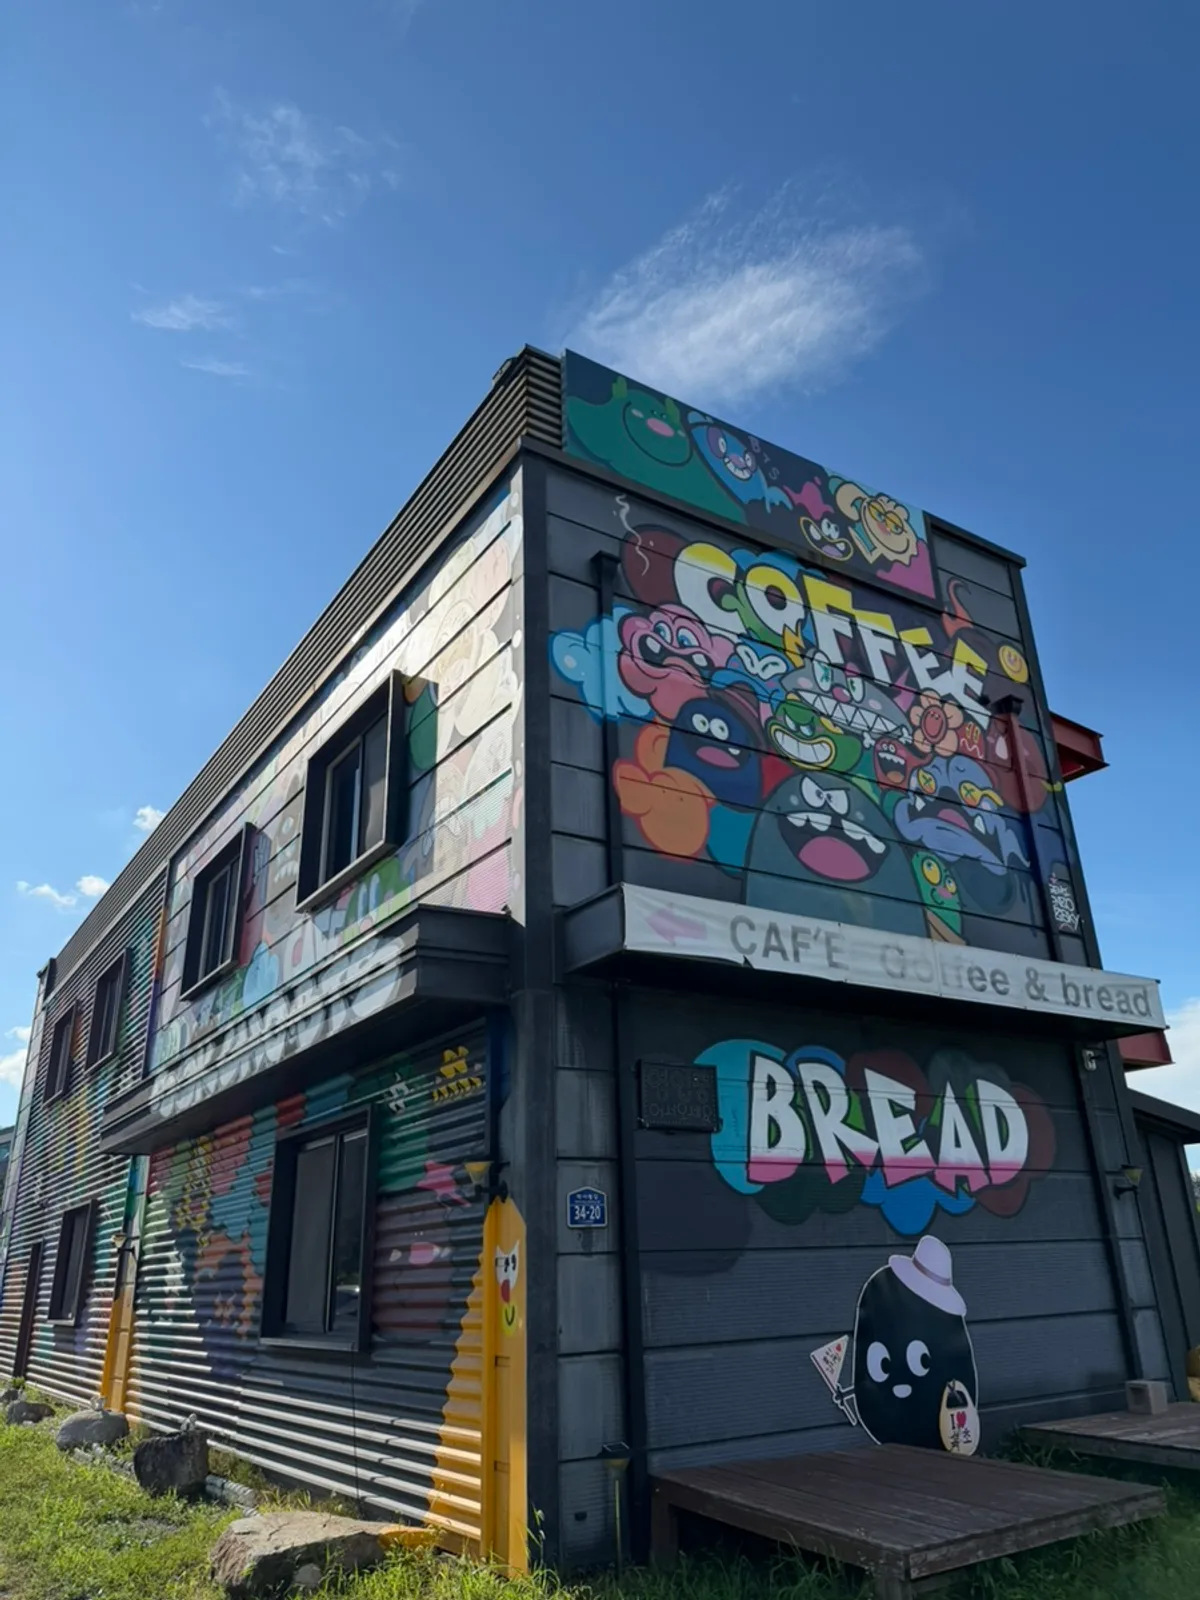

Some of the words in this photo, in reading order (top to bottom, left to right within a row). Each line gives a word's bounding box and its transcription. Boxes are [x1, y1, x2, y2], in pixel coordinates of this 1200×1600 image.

[674, 542, 991, 730] COFFEE
[1025, 966, 1050, 1002] &
[1061, 972, 1152, 1018] bread
[747, 1055, 1029, 1193] BREAD
[574, 1205, 601, 1220] 34-20
